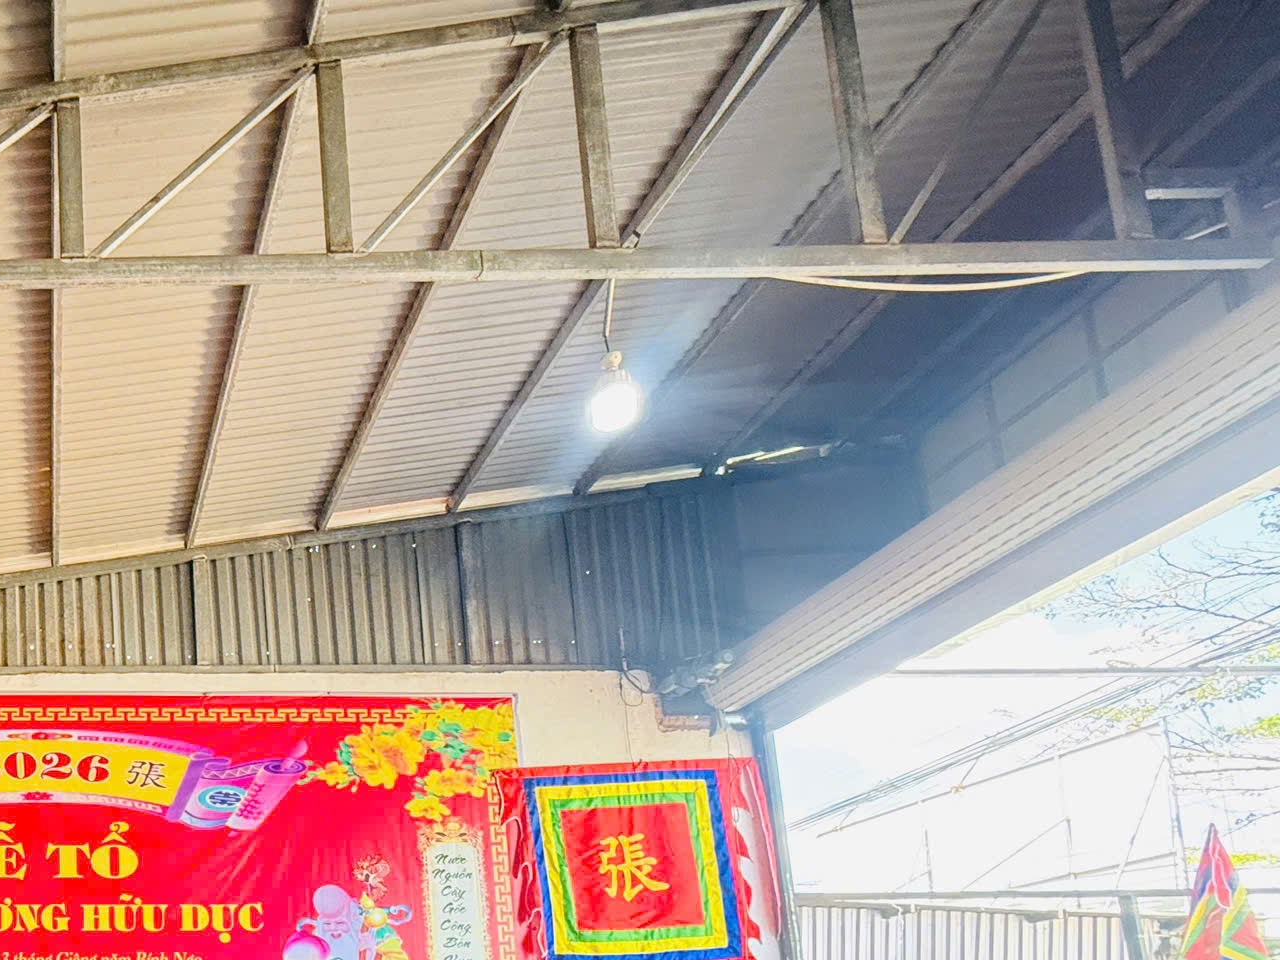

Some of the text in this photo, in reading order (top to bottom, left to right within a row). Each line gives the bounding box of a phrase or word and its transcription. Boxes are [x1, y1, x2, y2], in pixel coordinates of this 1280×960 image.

[126, 759, 168, 788] 張
[46, 821, 139, 880] TỔ
[599, 833, 670, 902] 張
[80, 894, 168, 932] HỮU
[180, 903, 265, 943] DỤC
